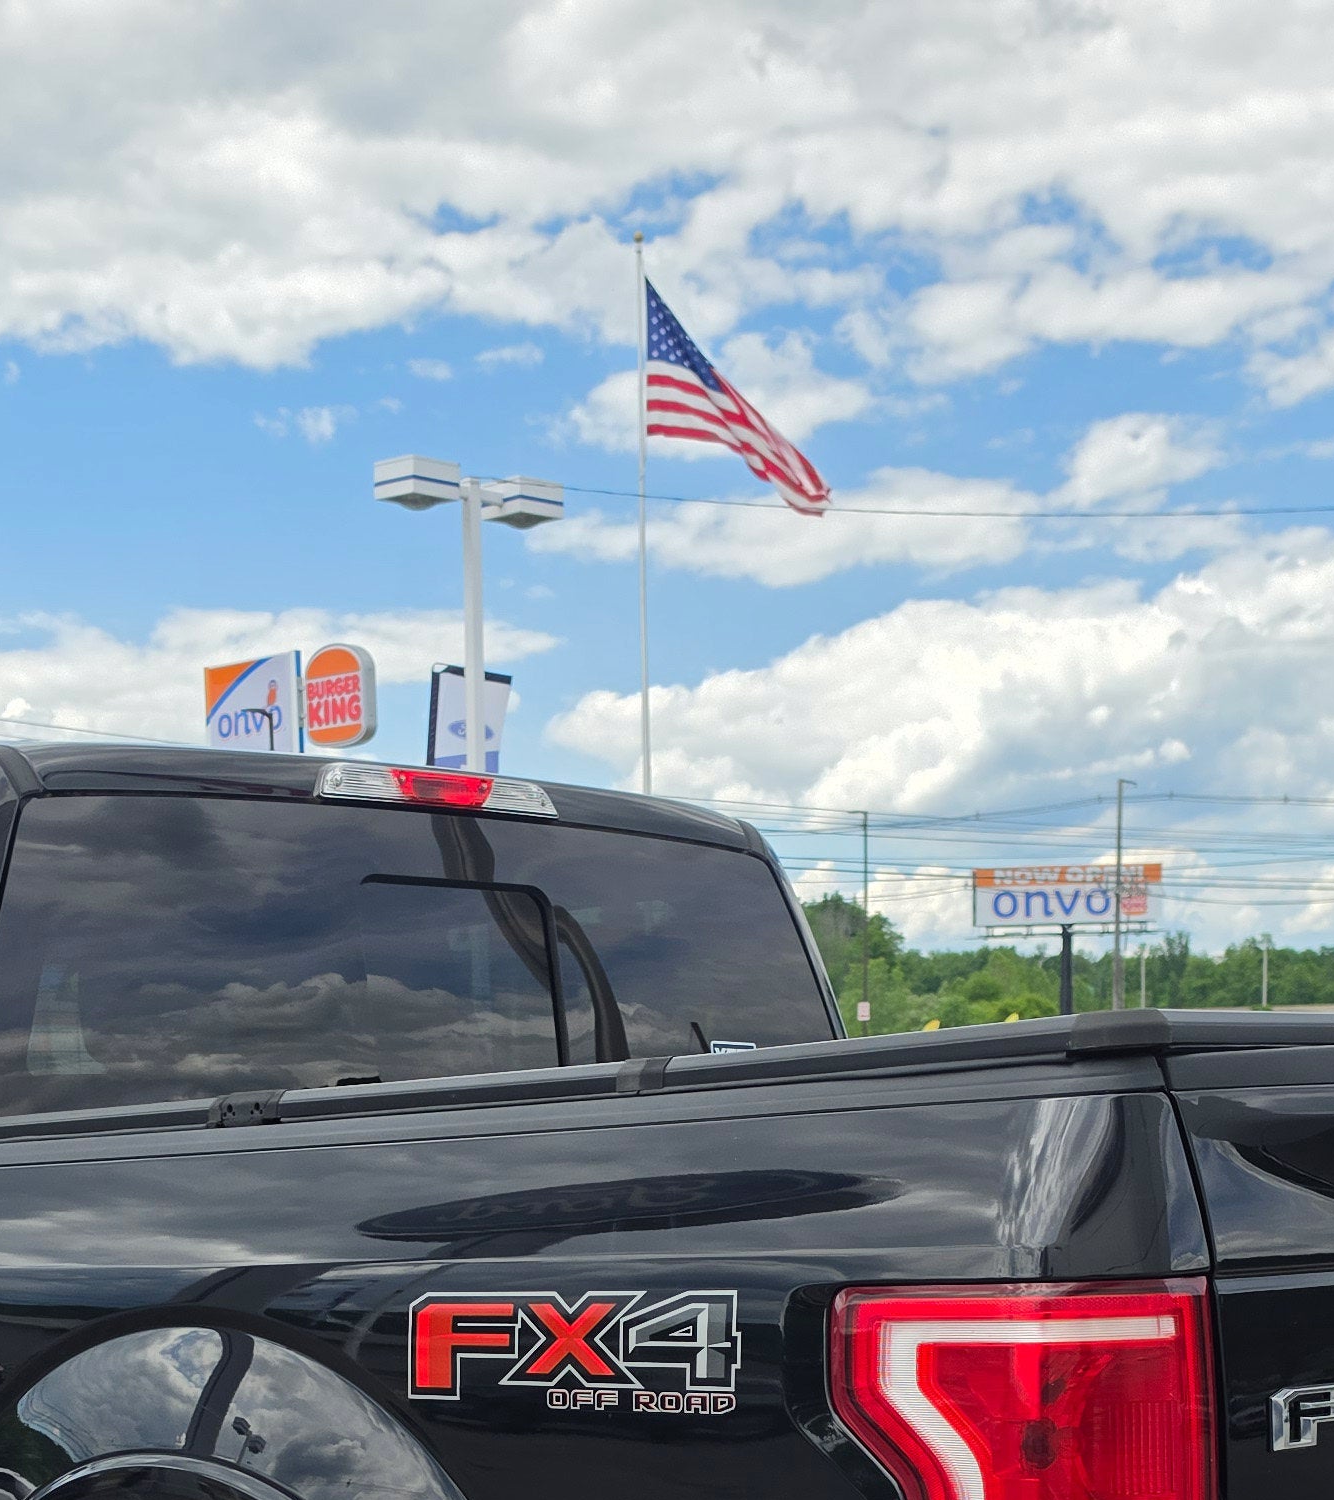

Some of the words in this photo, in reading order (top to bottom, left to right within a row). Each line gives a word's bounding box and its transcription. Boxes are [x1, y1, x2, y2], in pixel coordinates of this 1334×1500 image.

[306, 674, 361, 698] BURGER
[218, 703, 283, 739] onvo
[308, 695, 362, 729] KING
[994, 866, 1062, 886] NOW
[992, 887, 1112, 919] onvo
[408, 1290, 742, 1401] FX4
[546, 1388, 620, 1411] OFF
[632, 1390, 737, 1415] ROAD
